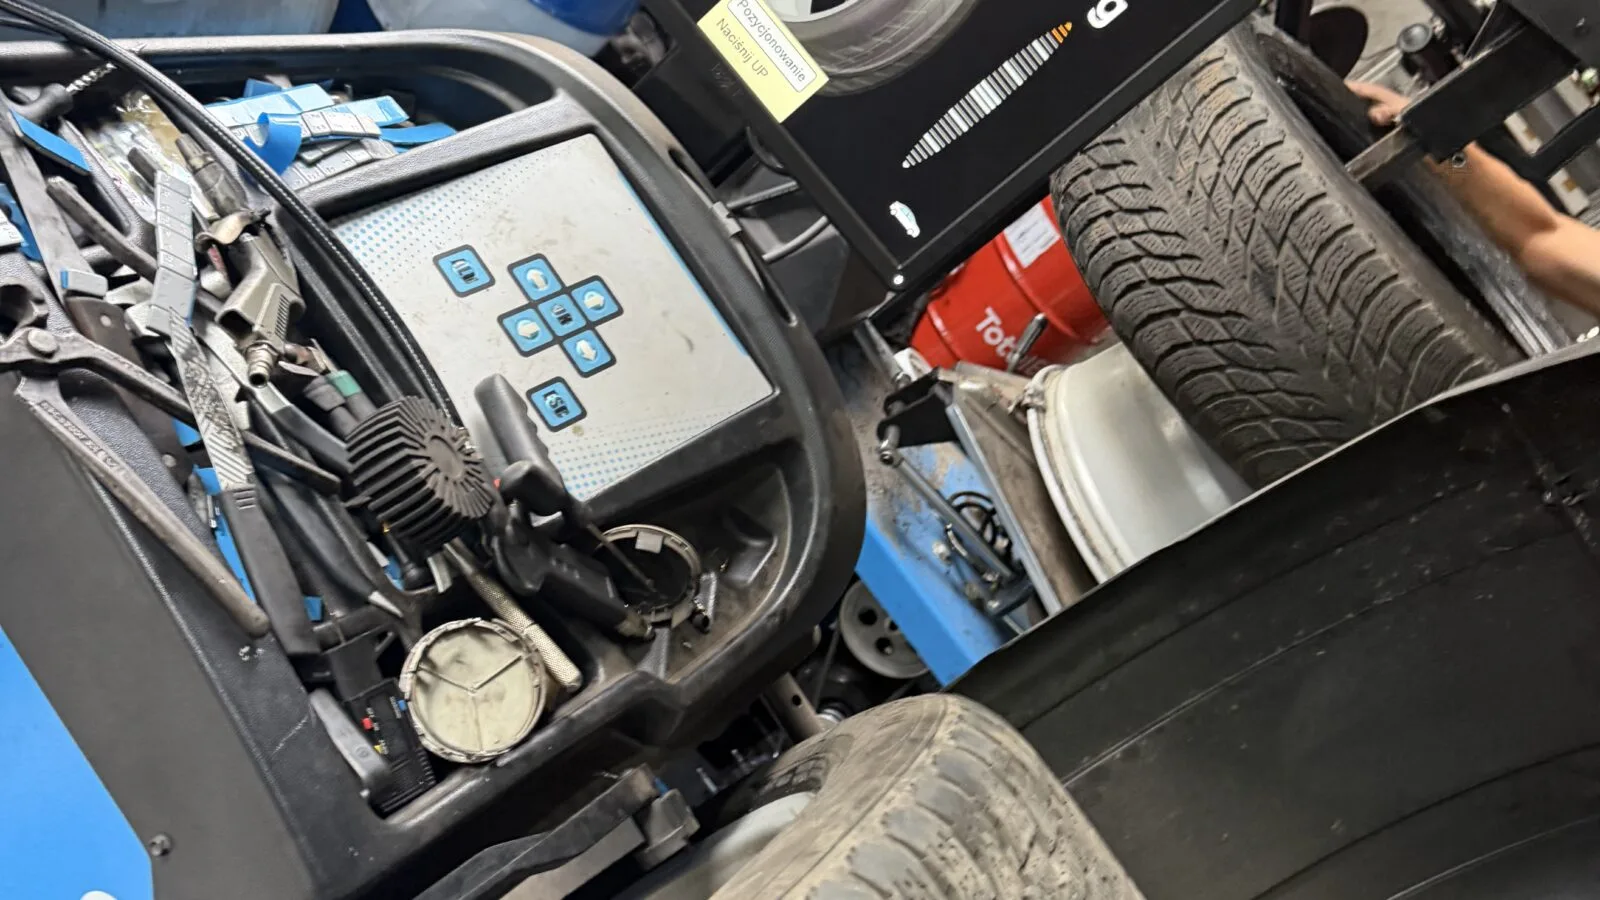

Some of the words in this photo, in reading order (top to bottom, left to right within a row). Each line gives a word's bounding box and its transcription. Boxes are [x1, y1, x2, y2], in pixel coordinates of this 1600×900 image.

[716, 18, 755, 64] Naciśnij
[751, 59, 769, 77] UP
[737, 0, 806, 82] Pozycjonowanie
